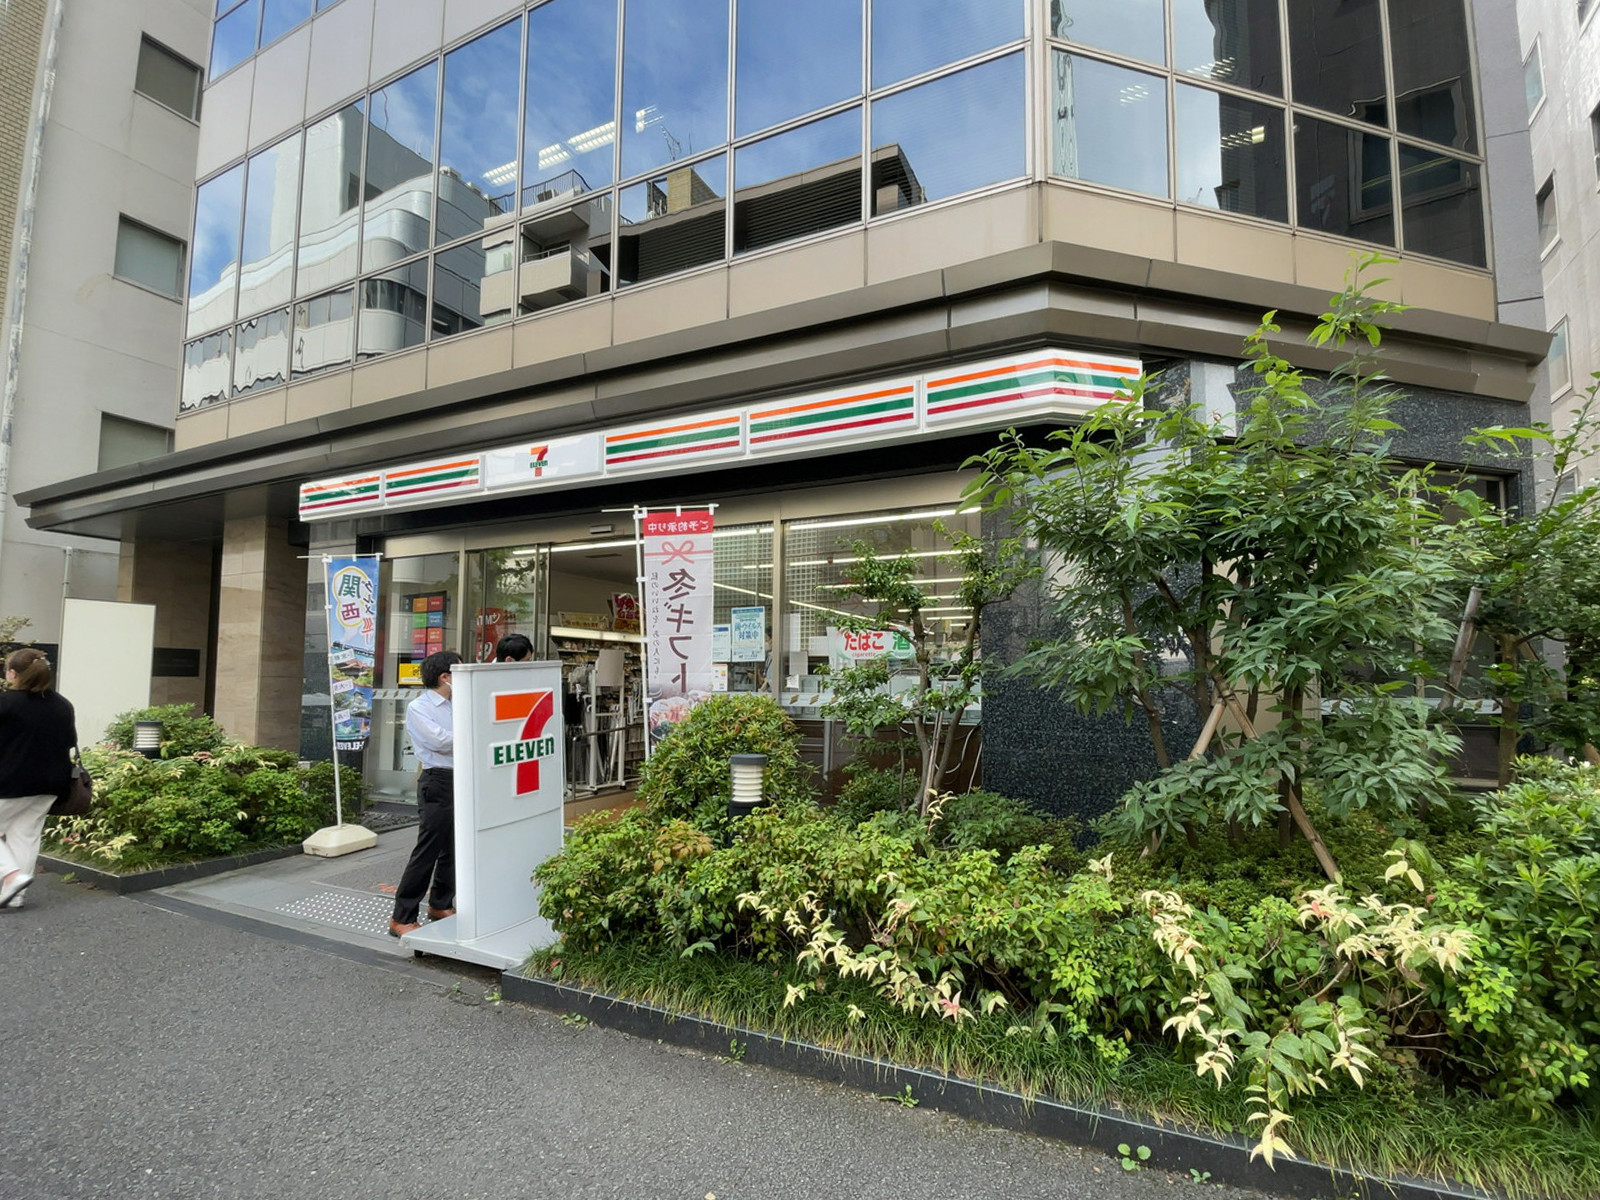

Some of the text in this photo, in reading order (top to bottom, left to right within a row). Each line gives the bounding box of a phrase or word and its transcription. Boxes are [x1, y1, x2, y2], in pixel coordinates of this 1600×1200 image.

[530, 445, 549, 477] 7
[844, 632, 885, 651] たばこ
[892, 631, 910, 650] 酒
[495, 691, 554, 795] 7
